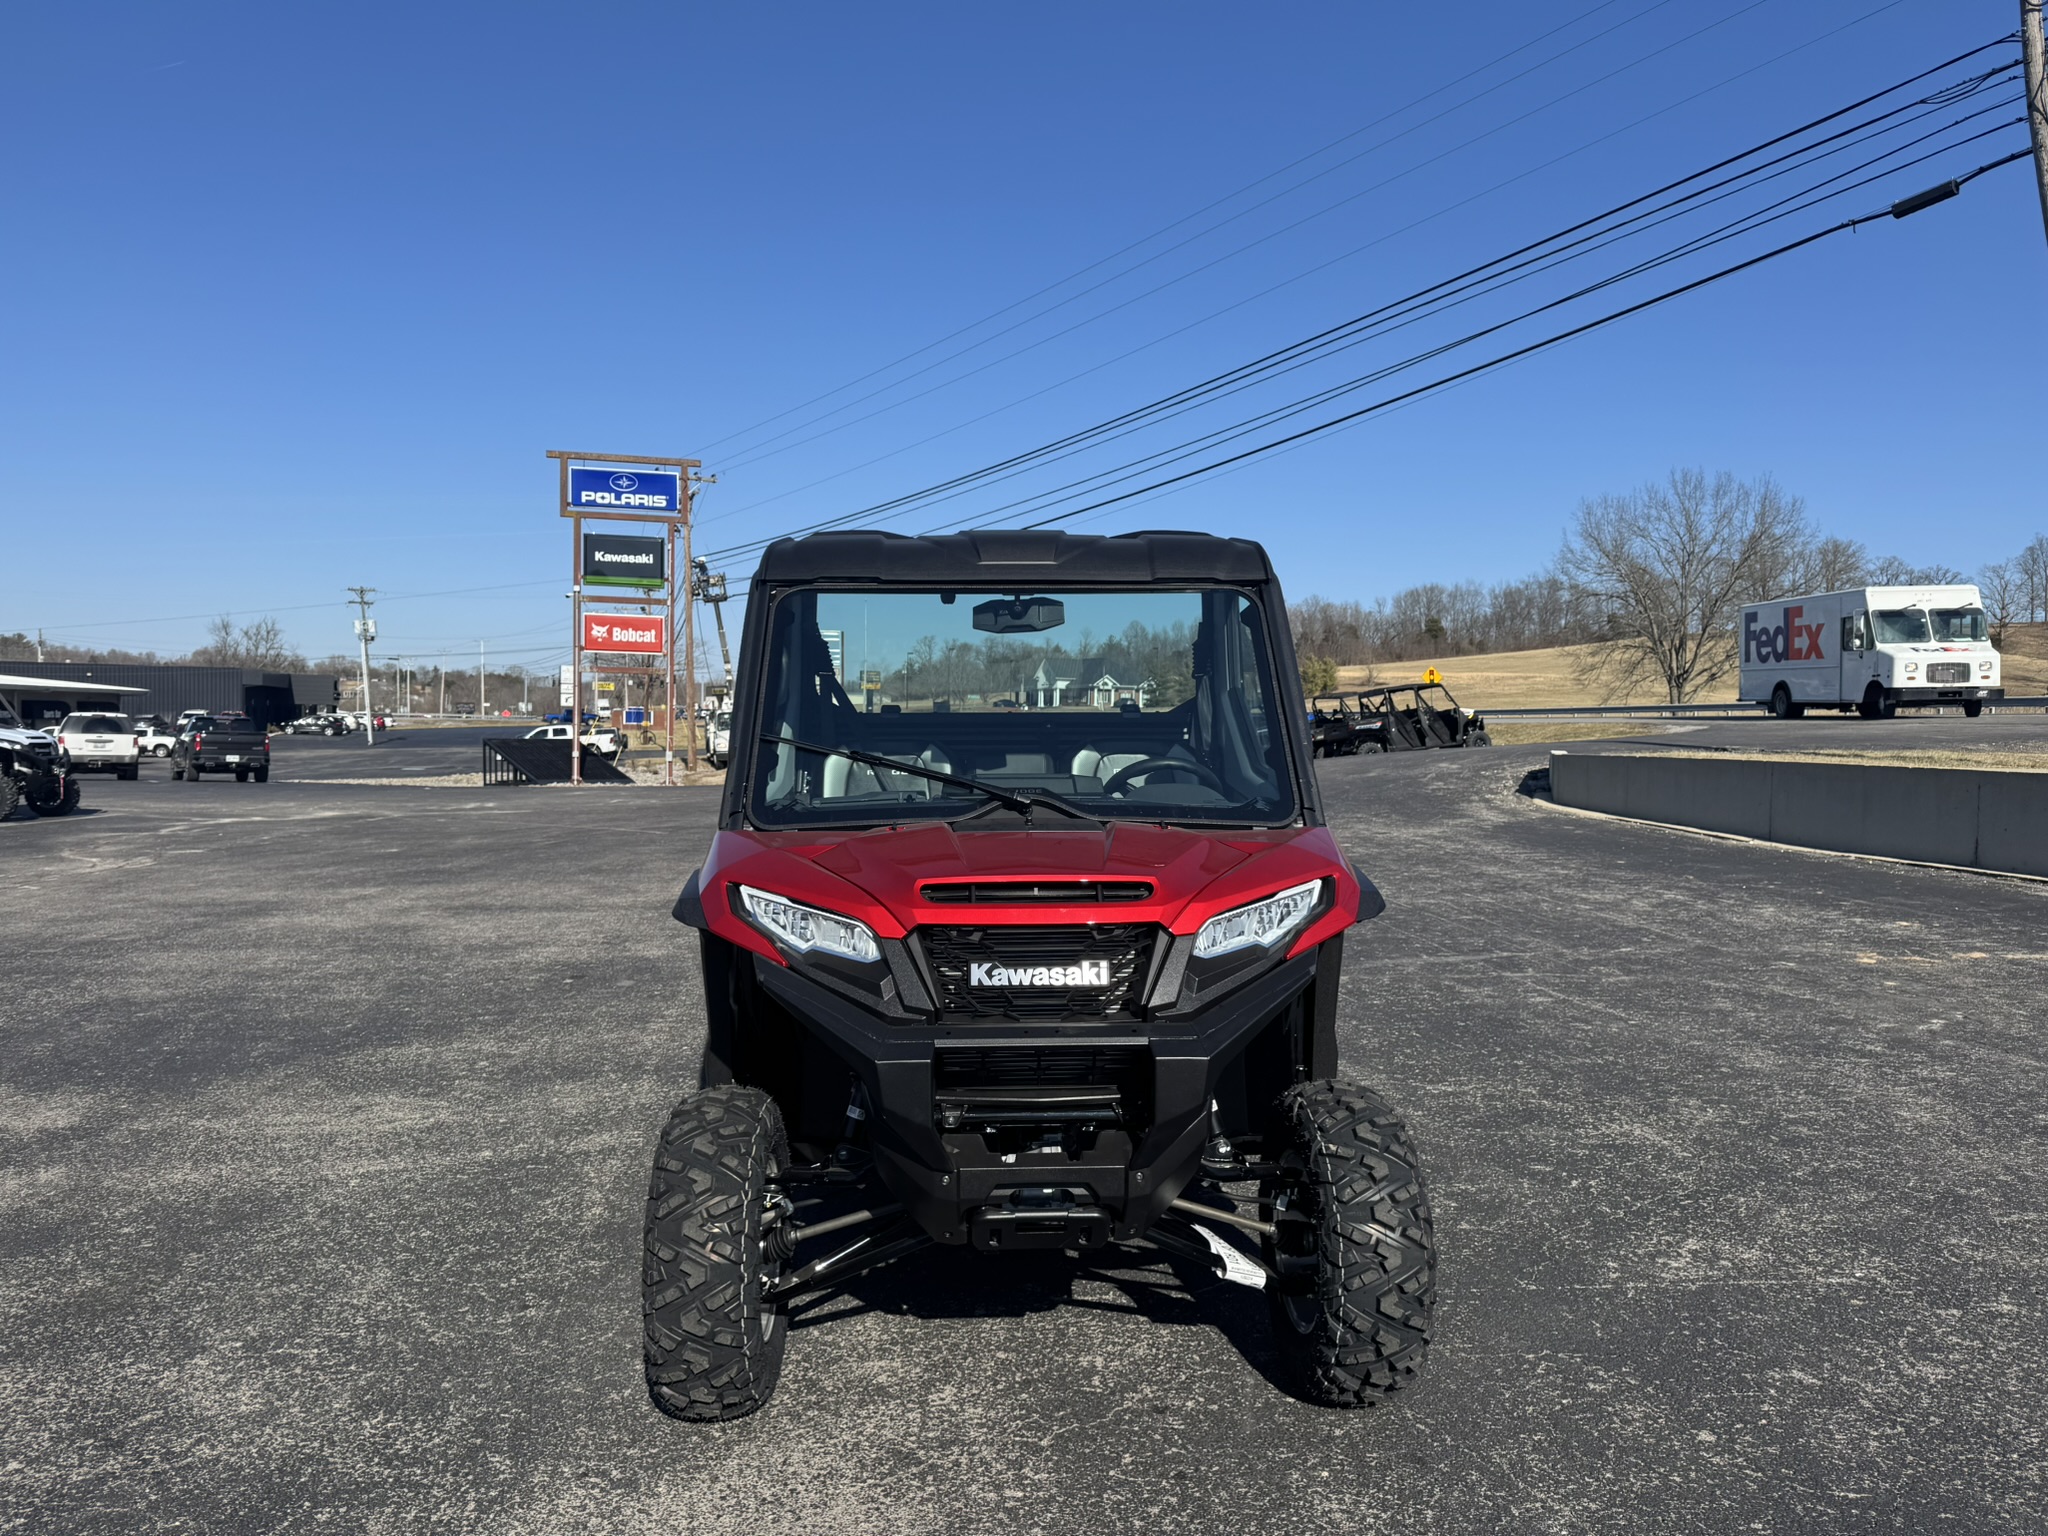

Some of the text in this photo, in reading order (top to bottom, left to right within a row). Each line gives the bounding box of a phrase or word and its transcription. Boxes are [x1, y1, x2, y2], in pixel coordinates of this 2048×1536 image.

[581, 491, 667, 507] POLARIS
[594, 551, 654, 564] Kawasaki
[612, 627, 656, 643] Bobcat
[1744, 605, 1825, 664] FedEx
[970, 960, 1108, 986] Kawasaki
